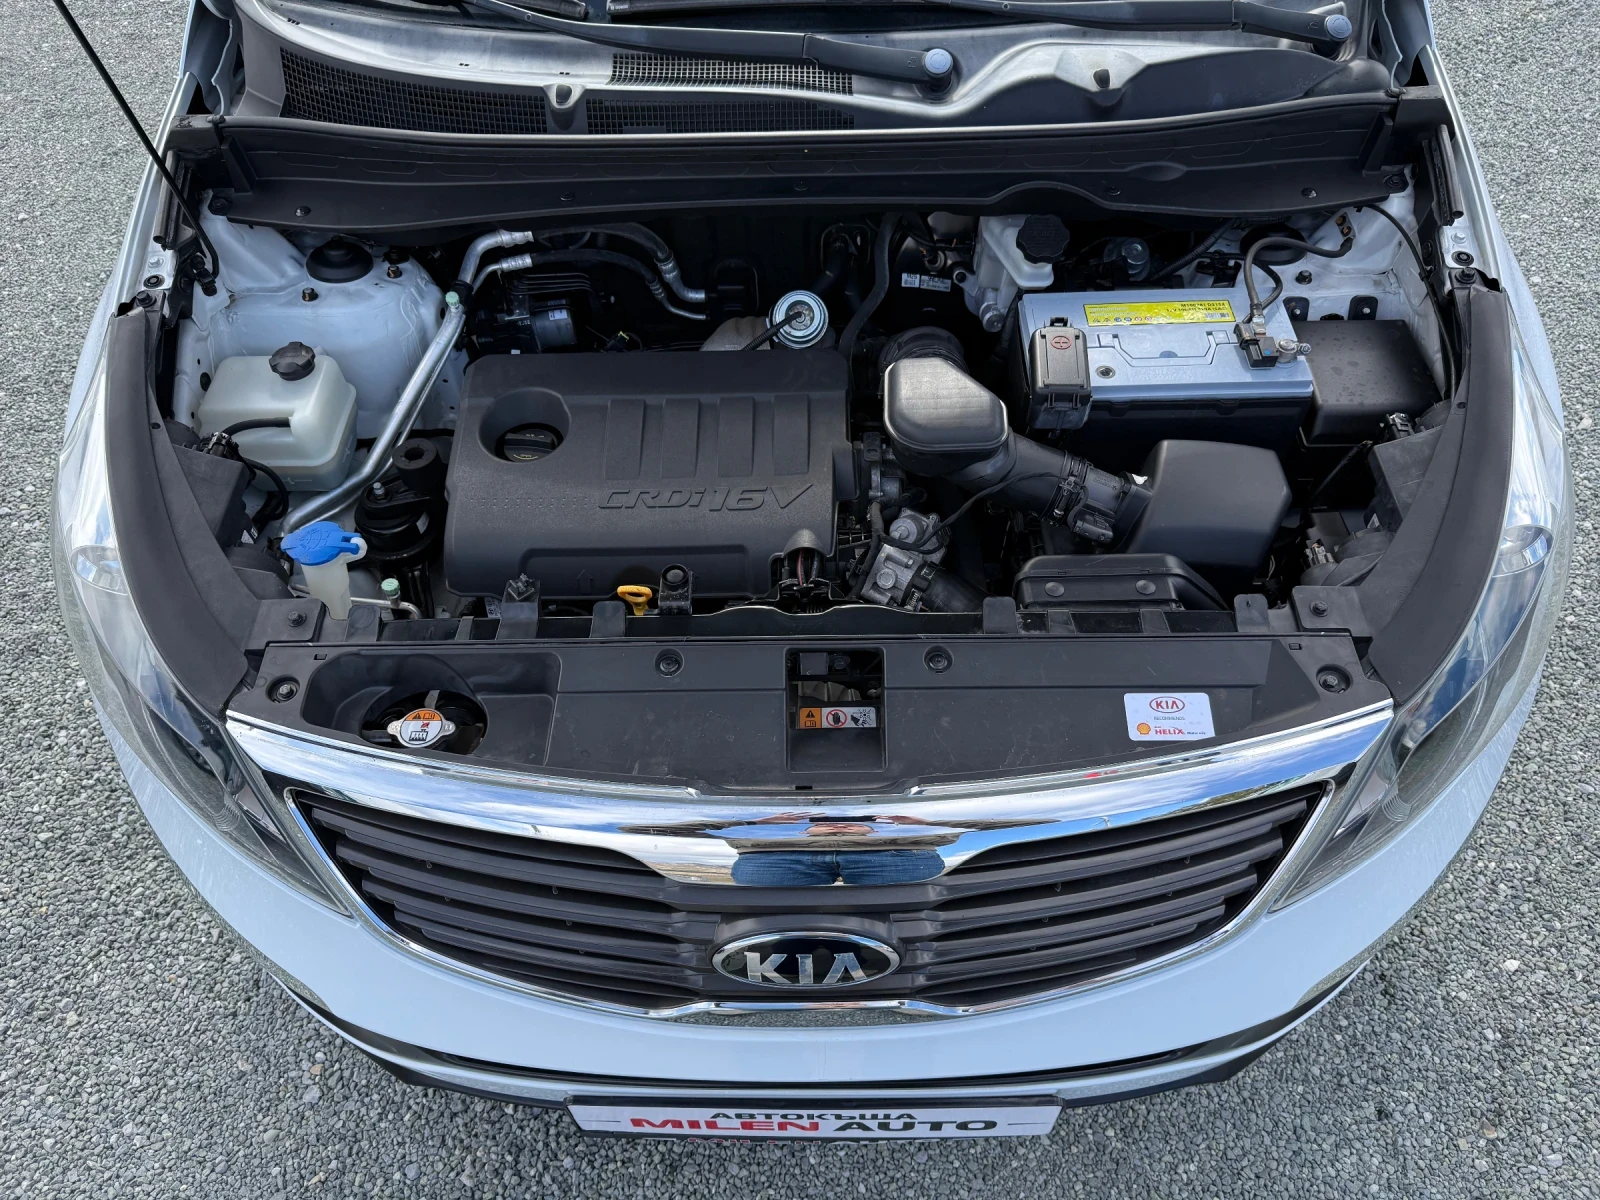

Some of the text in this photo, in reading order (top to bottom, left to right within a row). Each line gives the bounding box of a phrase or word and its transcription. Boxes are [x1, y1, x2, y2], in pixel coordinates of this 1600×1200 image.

[598, 483, 814, 512] CRDi 16V
[1155, 701, 1180, 710] KIA
[743, 951, 868, 985] KIA
[629, 1117, 998, 1132] MILEN AUTO
